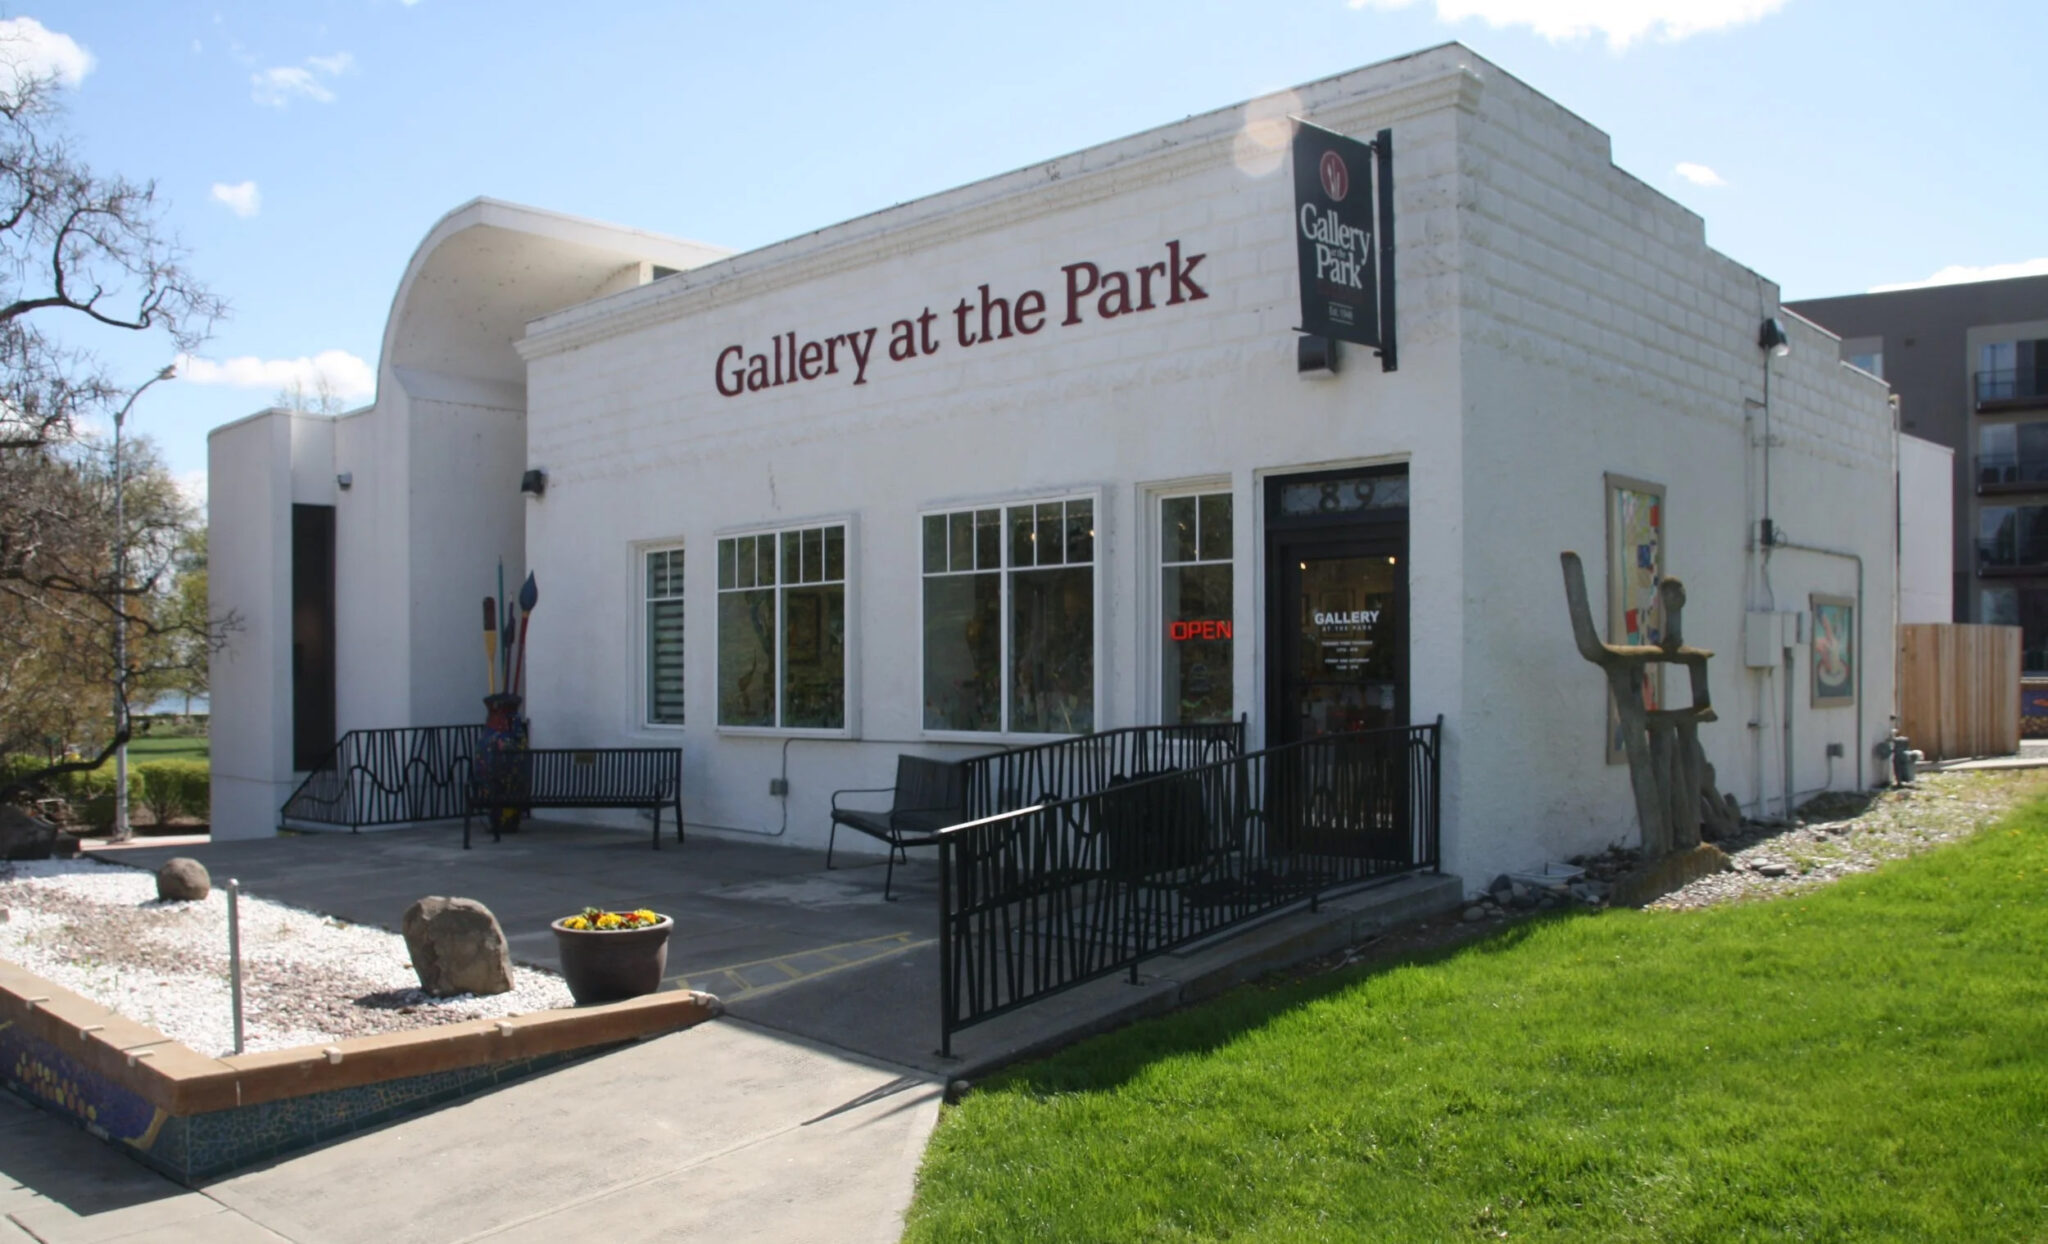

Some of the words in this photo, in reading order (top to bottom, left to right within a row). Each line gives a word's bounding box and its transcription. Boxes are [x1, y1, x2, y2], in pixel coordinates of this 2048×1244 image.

[1301, 202, 1371, 266] Gallery
[1316, 243, 1363, 289] Park
[715, 328, 877, 397] Gallery
[889, 306, 940, 361] at
[953, 283, 1046, 347] the
[1061, 239, 1209, 326] Park
[1170, 620, 1233, 640] OPEN
[1314, 610, 1379, 625] GALLERY
